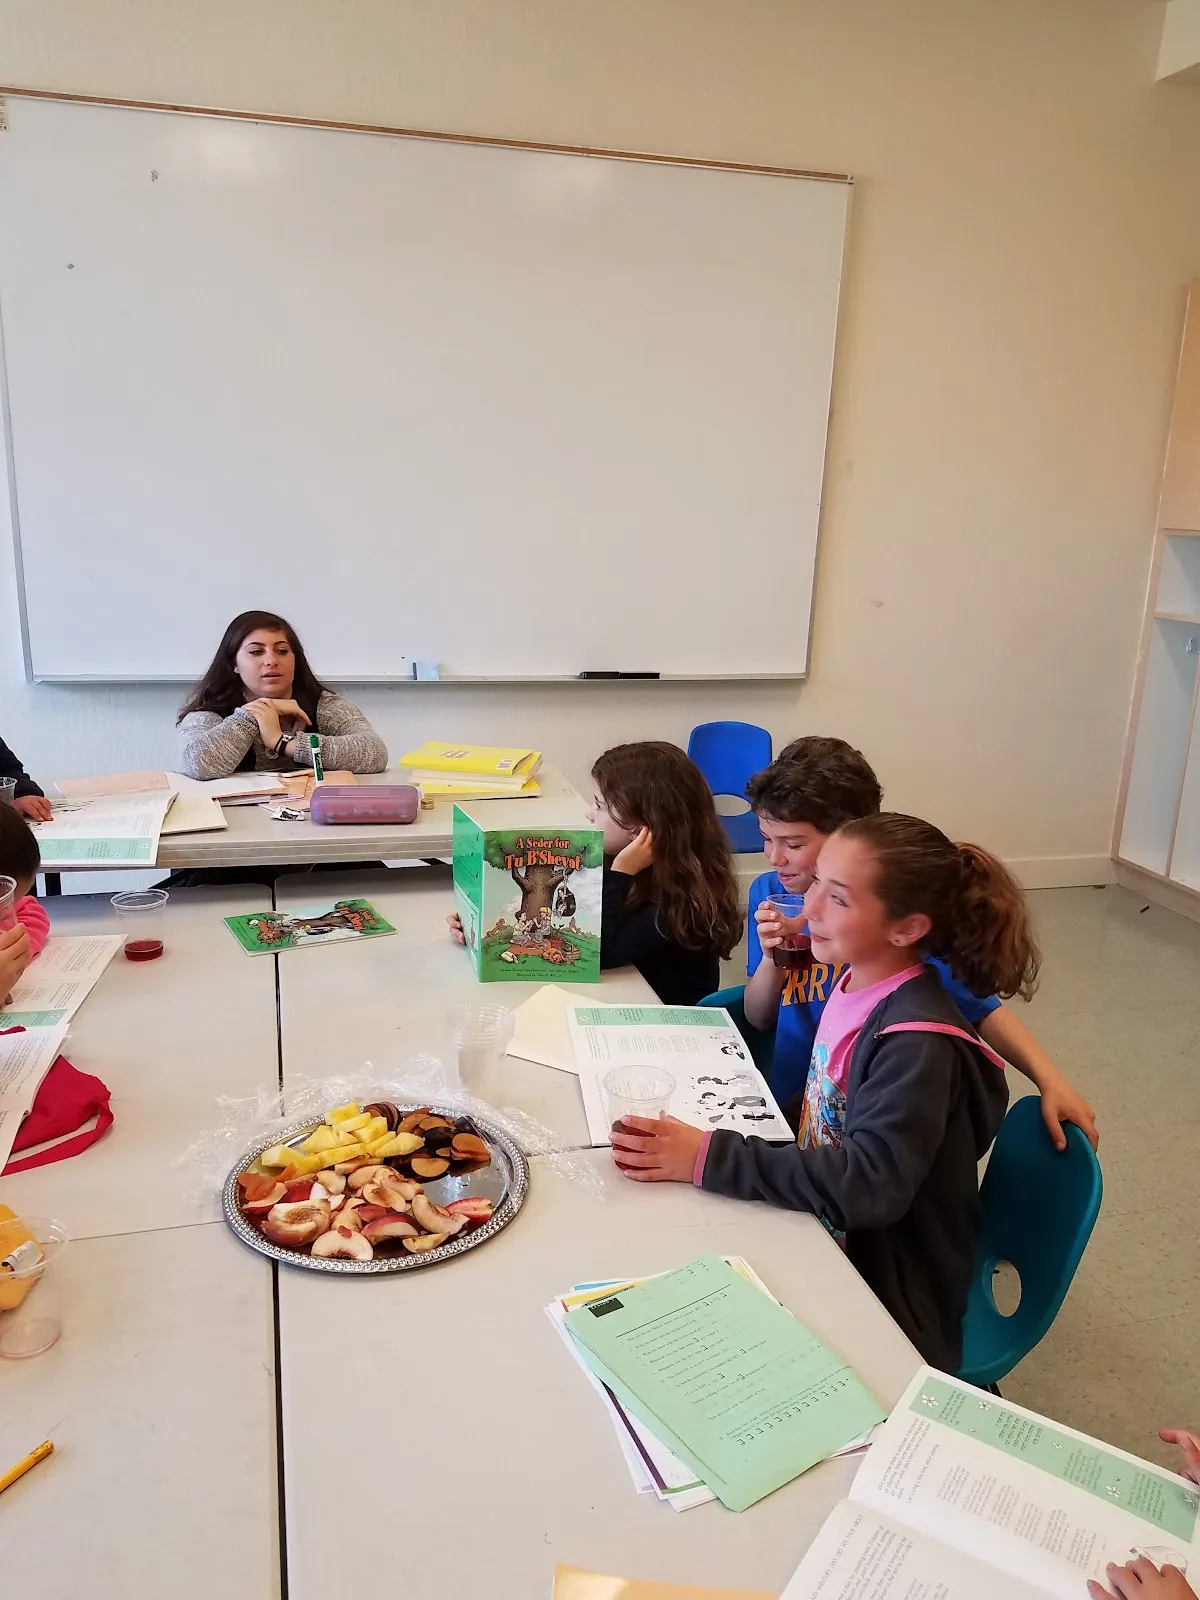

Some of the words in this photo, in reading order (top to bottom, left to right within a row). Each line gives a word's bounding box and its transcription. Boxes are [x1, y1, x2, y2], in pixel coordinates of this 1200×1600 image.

[516, 837, 525, 849] A
[526, 836, 553, 849] Seder
[555, 836, 570, 849] for
[505, 853, 524, 871] Tu
[527, 850, 582, 871] B'Shevat
